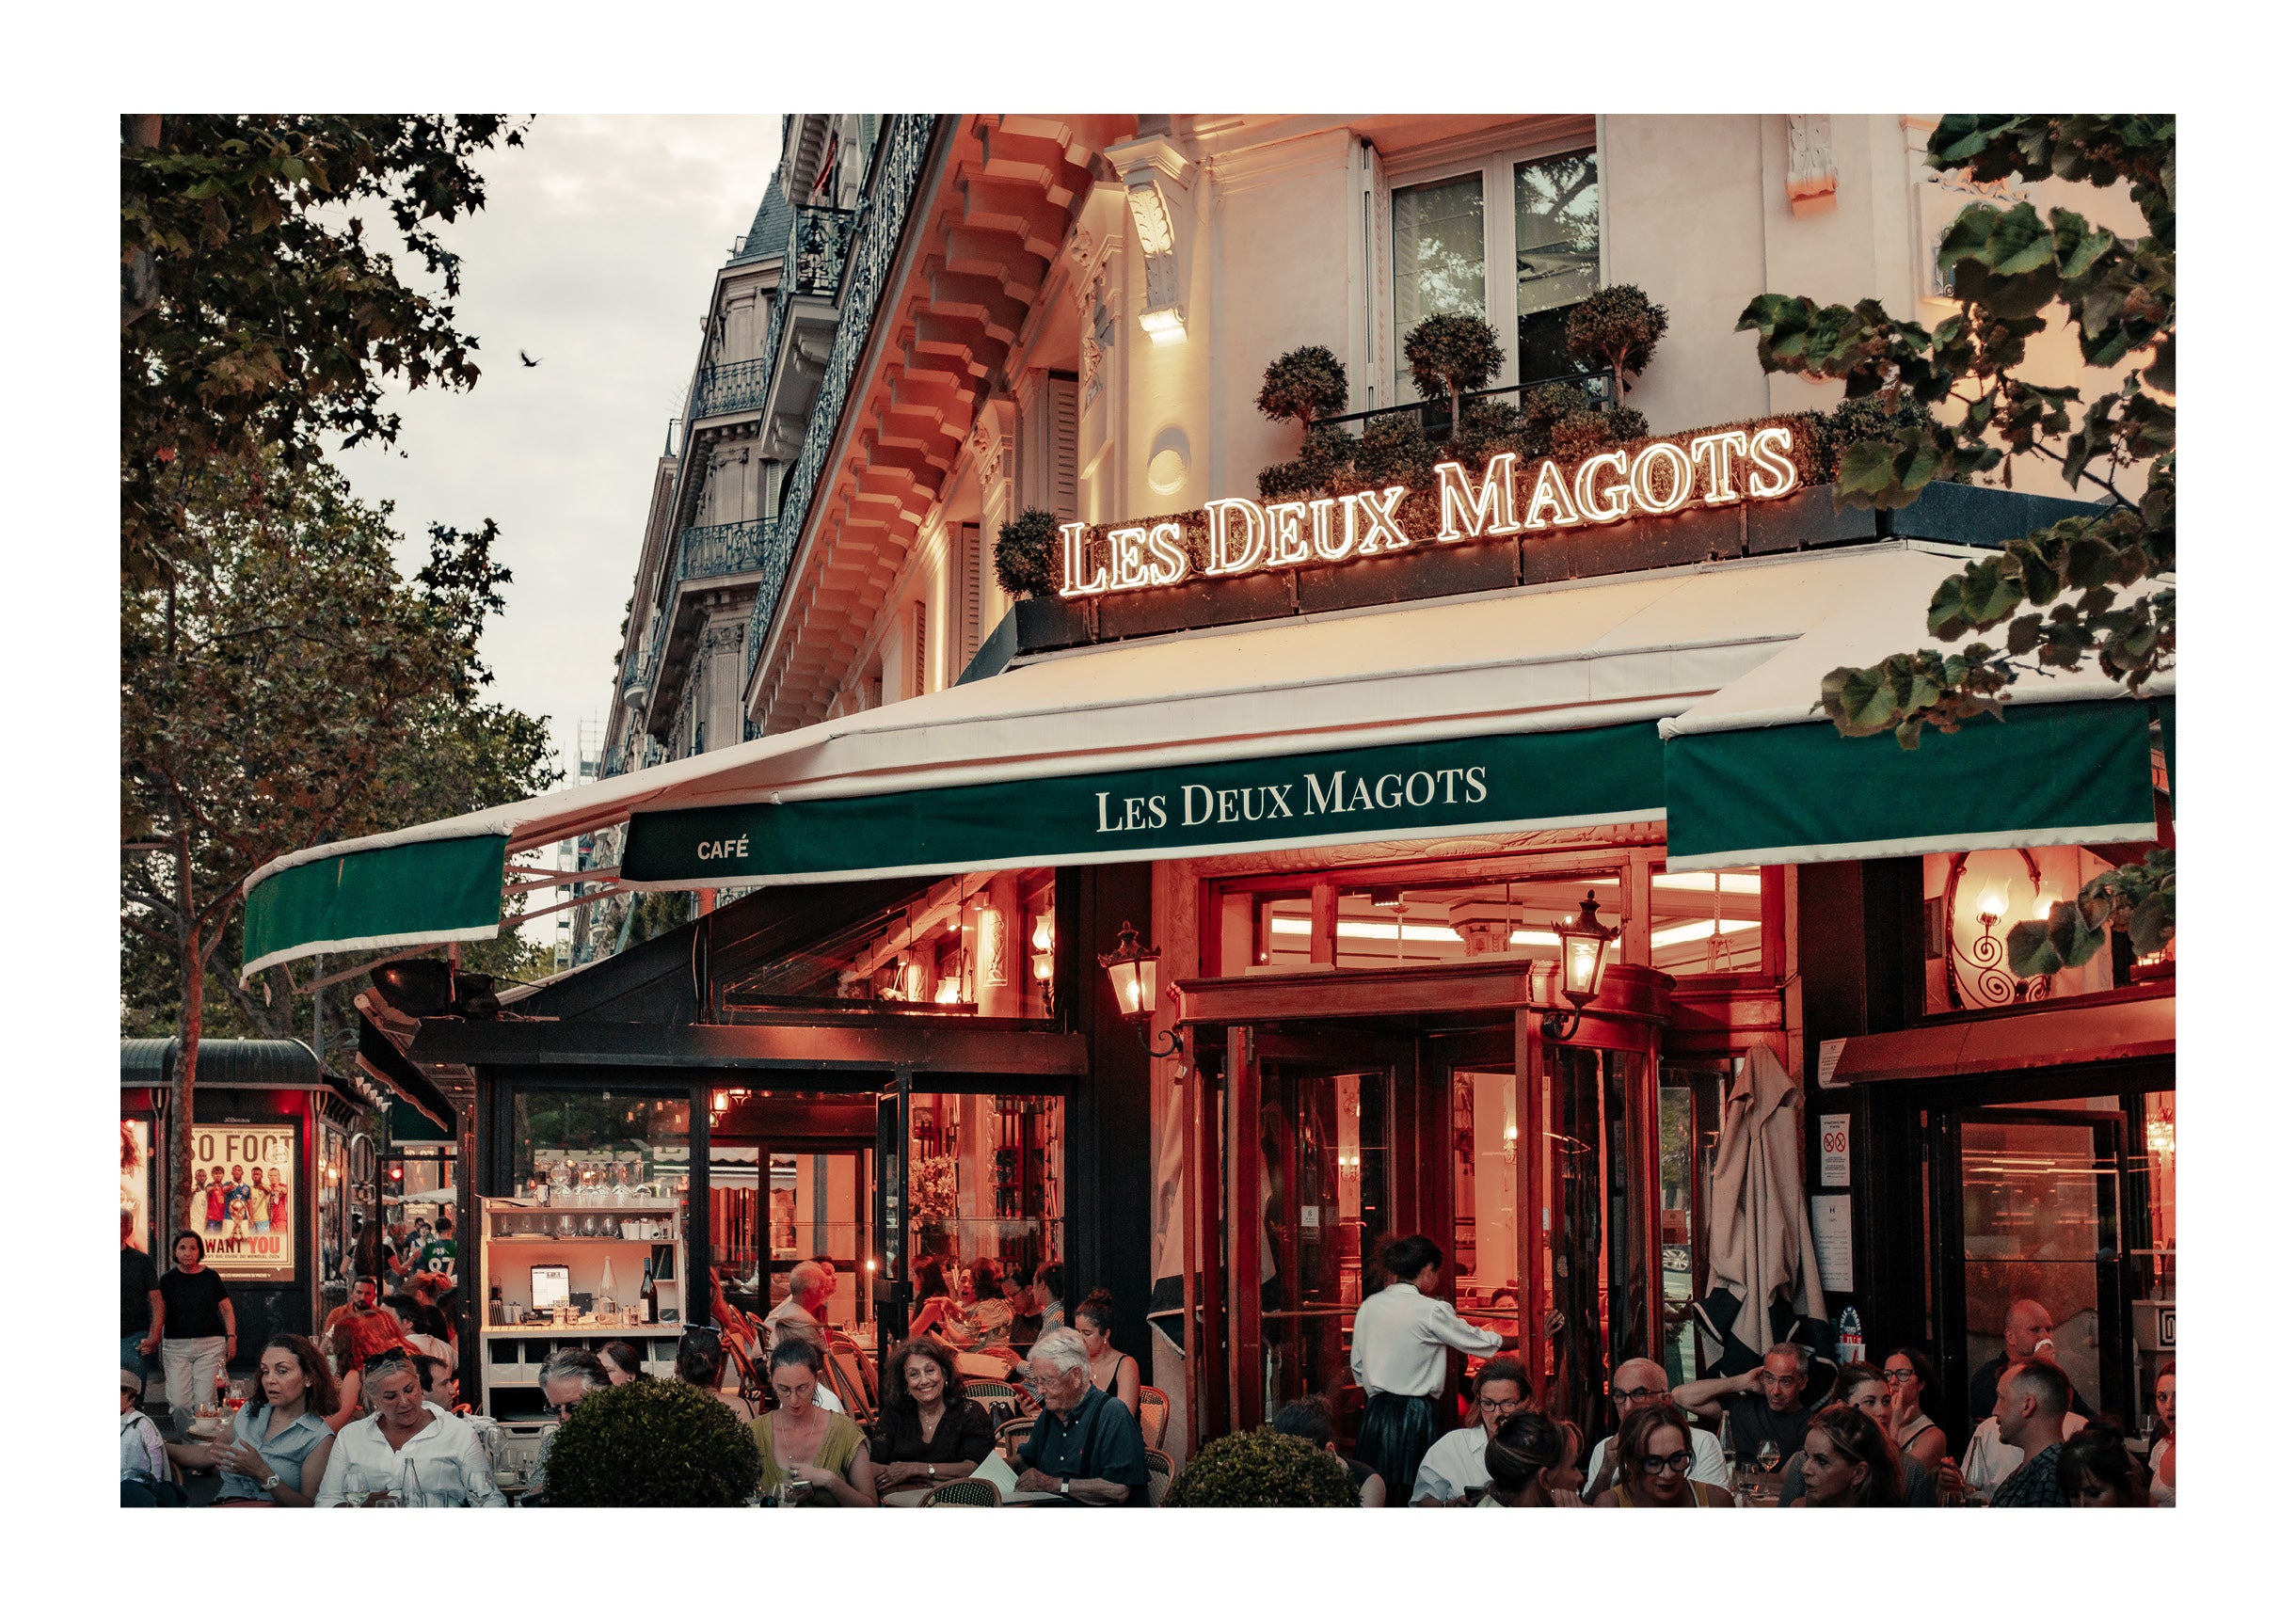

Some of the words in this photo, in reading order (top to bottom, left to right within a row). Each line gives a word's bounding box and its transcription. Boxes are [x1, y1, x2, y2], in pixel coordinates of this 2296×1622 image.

[1059, 521, 1189, 597] LES
[1204, 485, 1410, 575] DEUX
[1434, 427, 1798, 543] MAGOTS
[1095, 791, 1167, 833] LES
[1180, 783, 1293, 826] DEUX
[1303, 766, 1487, 817] MAGOTS
[697, 833, 749, 860] CAFÉ
[205, 1238, 241, 1253] WANT
[247, 1236, 280, 1254] YOU
